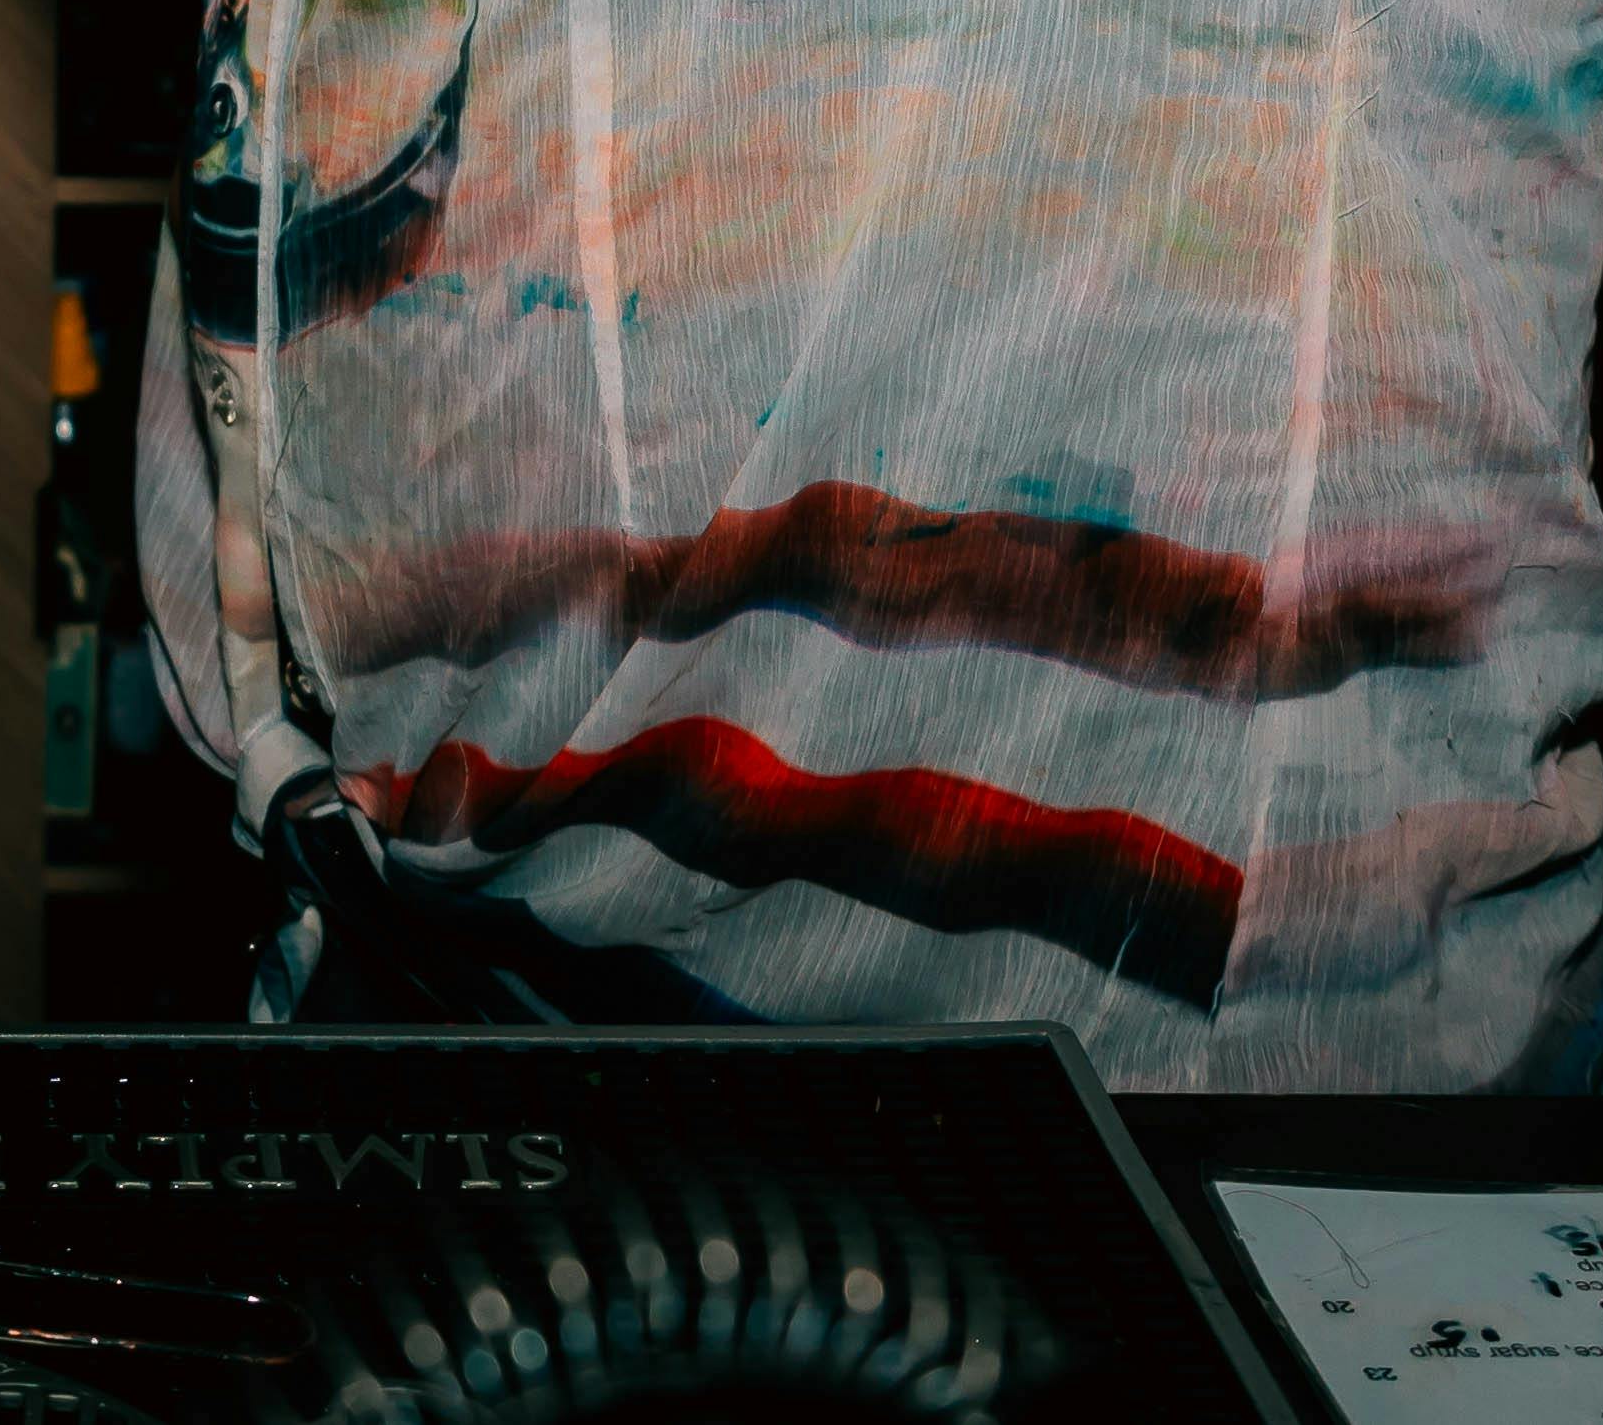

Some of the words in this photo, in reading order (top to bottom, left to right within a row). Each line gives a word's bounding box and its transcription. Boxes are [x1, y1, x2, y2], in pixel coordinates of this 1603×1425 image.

[41, 1131, 571, 1191] SIMPLY
[1322, 1300, 1355, 1314] 20
[1410, 1344, 1481, 1359] syrup
[1489, 1345, 1560, 1358] sugar
[1362, 1367, 1398, 1381] 23
